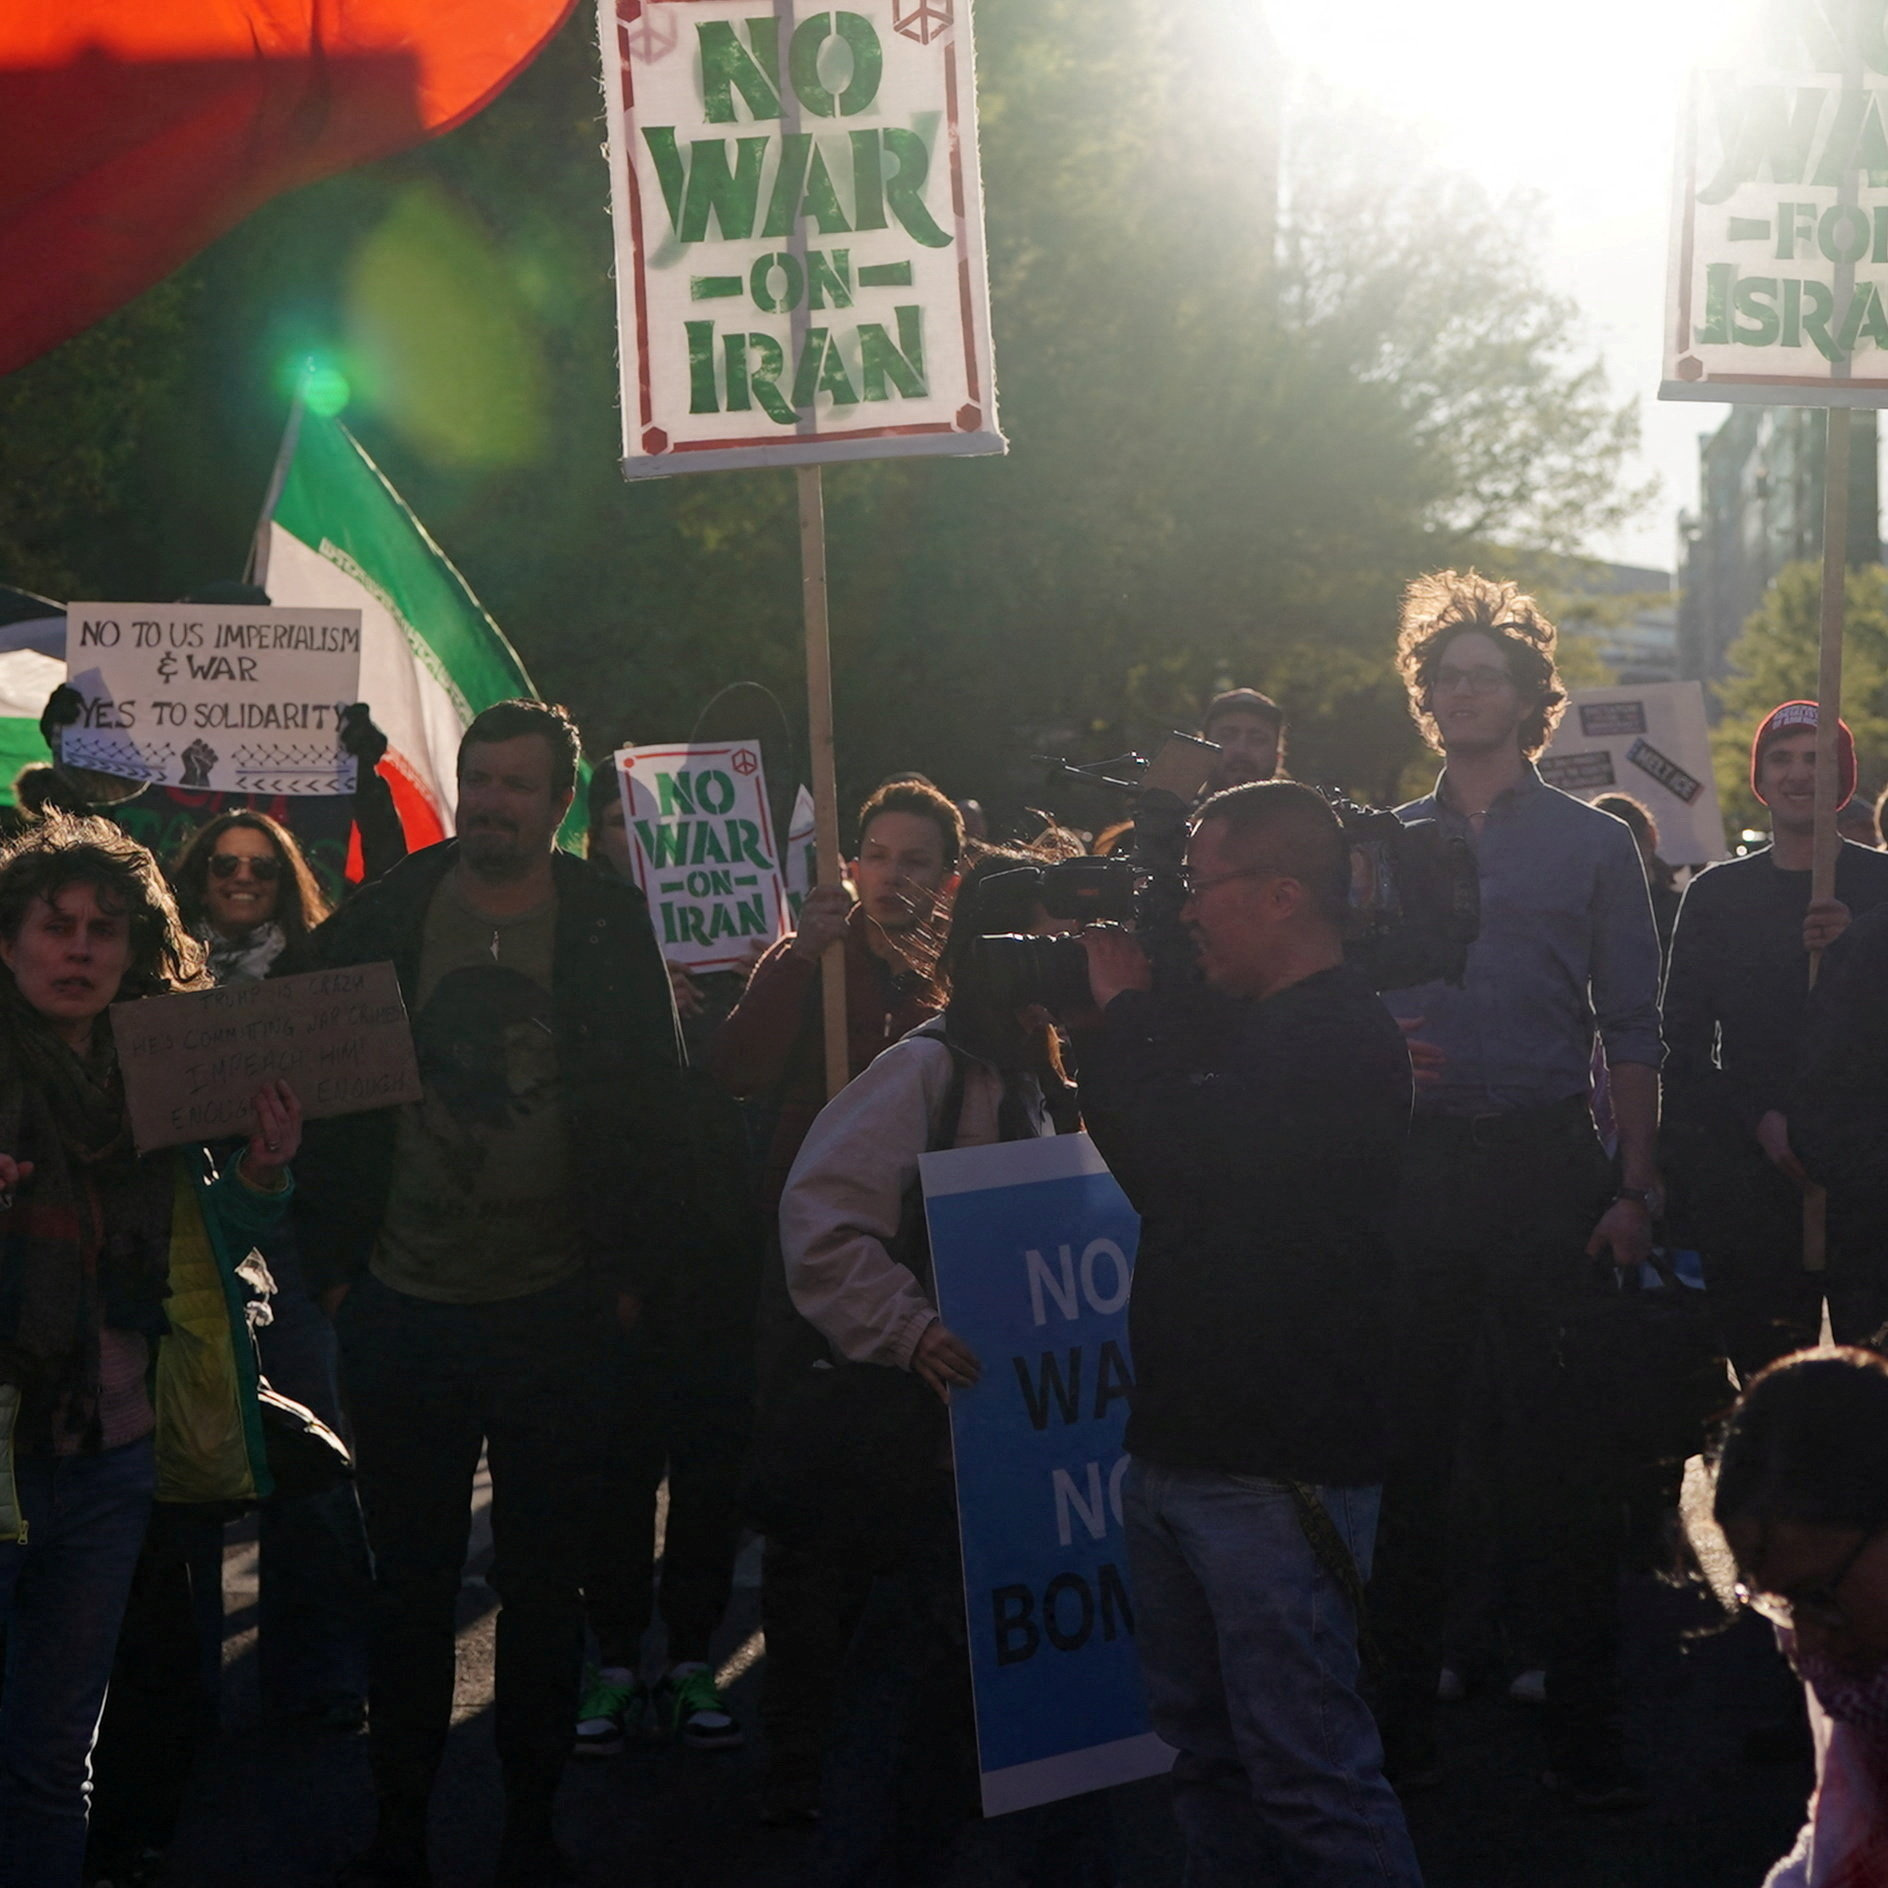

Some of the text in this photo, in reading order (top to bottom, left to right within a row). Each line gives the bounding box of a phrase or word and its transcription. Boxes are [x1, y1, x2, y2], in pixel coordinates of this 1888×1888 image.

[695, 11, 882, 124] NO
[642, 126, 953, 248] WAR
[684, 305, 928, 424] IRAN
[80, 620, 360, 653] NO TO US IMPERIALISM
[187, 655, 259, 683] WAR
[79, 697, 346, 731] YES TO SOLIDARITY
[655, 770, 735, 816] NO
[634, 819, 774, 870] WAR
[660, 893, 768, 947] IRAN
[307, 1012, 343, 1034] WAR
[185, 1052, 304, 1094] IMPEACH
[171, 1072, 406, 1131] ENOUG ENOUGH
[1026, 1238, 1132, 1326] NO
[1013, 1340, 1136, 1431] WA
